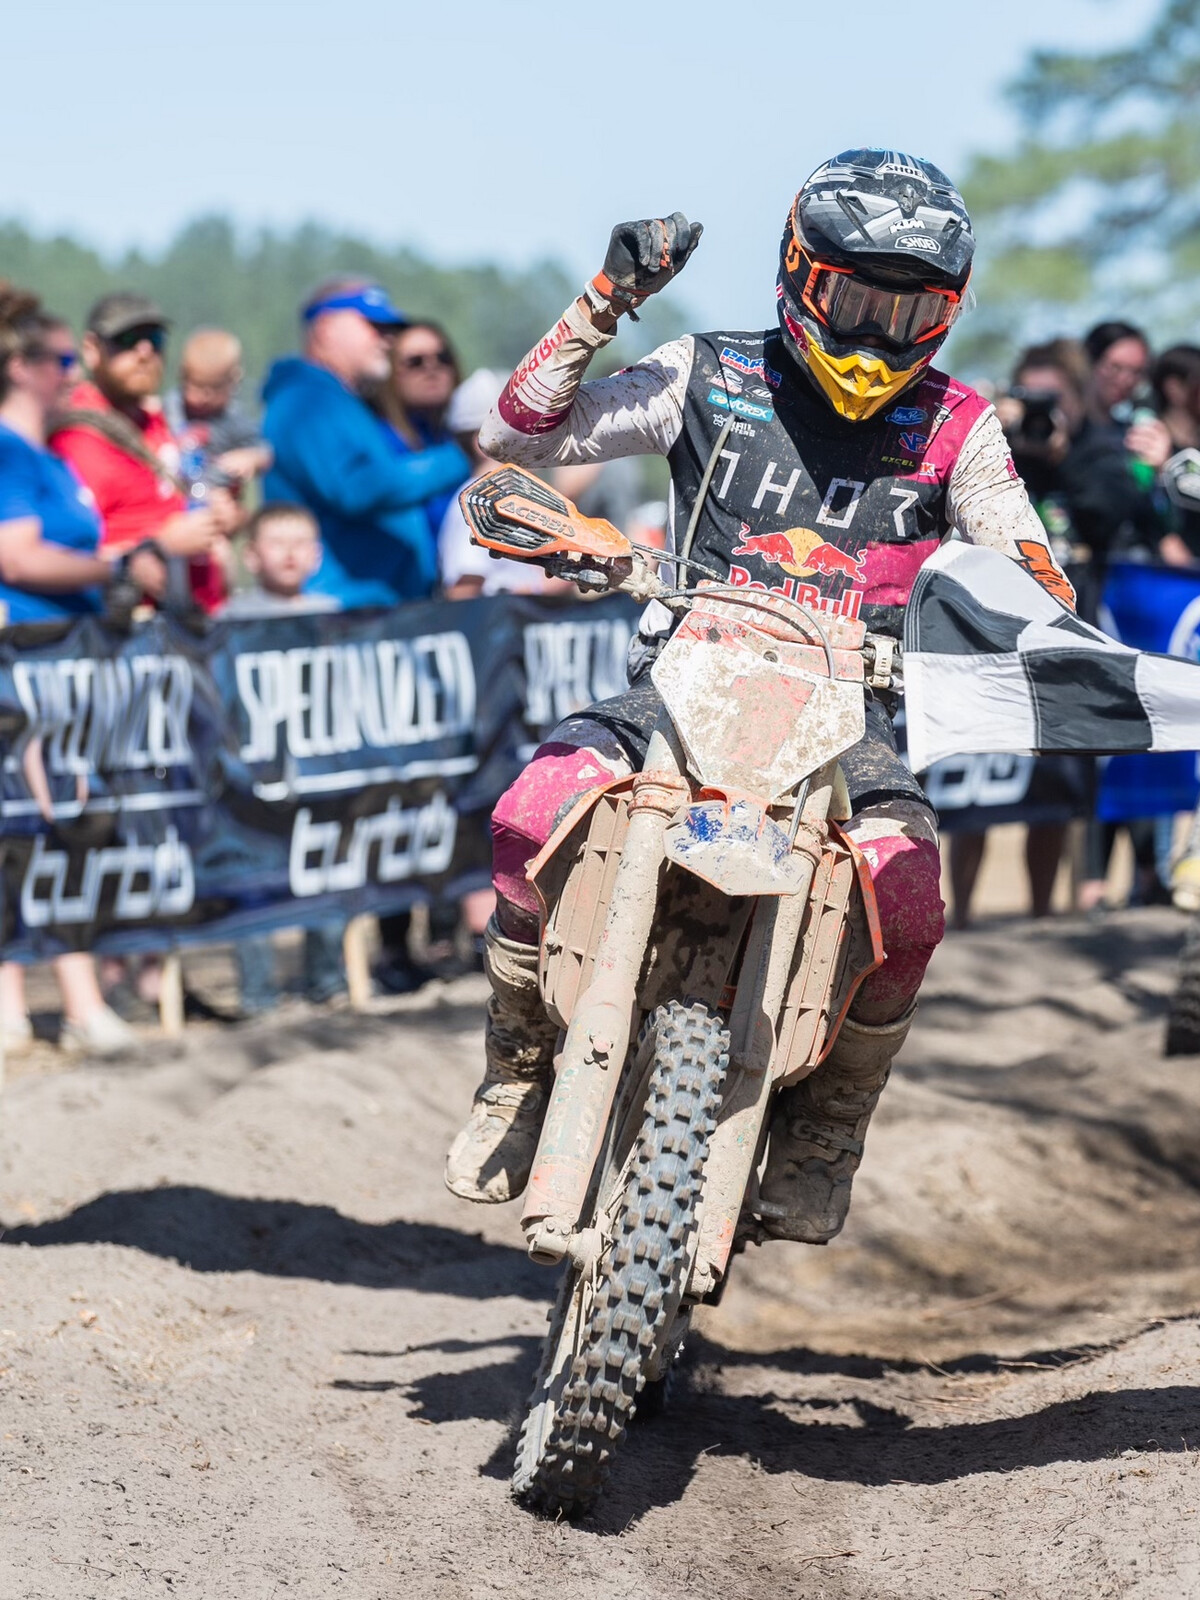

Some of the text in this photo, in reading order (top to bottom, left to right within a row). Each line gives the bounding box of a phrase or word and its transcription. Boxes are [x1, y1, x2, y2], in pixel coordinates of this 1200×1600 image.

[508, 347, 541, 398] Red
[881, 455, 916, 468] EXCEL
[234, 630, 478, 764] SPECIALIZED
[289, 789, 459, 898] turbo
